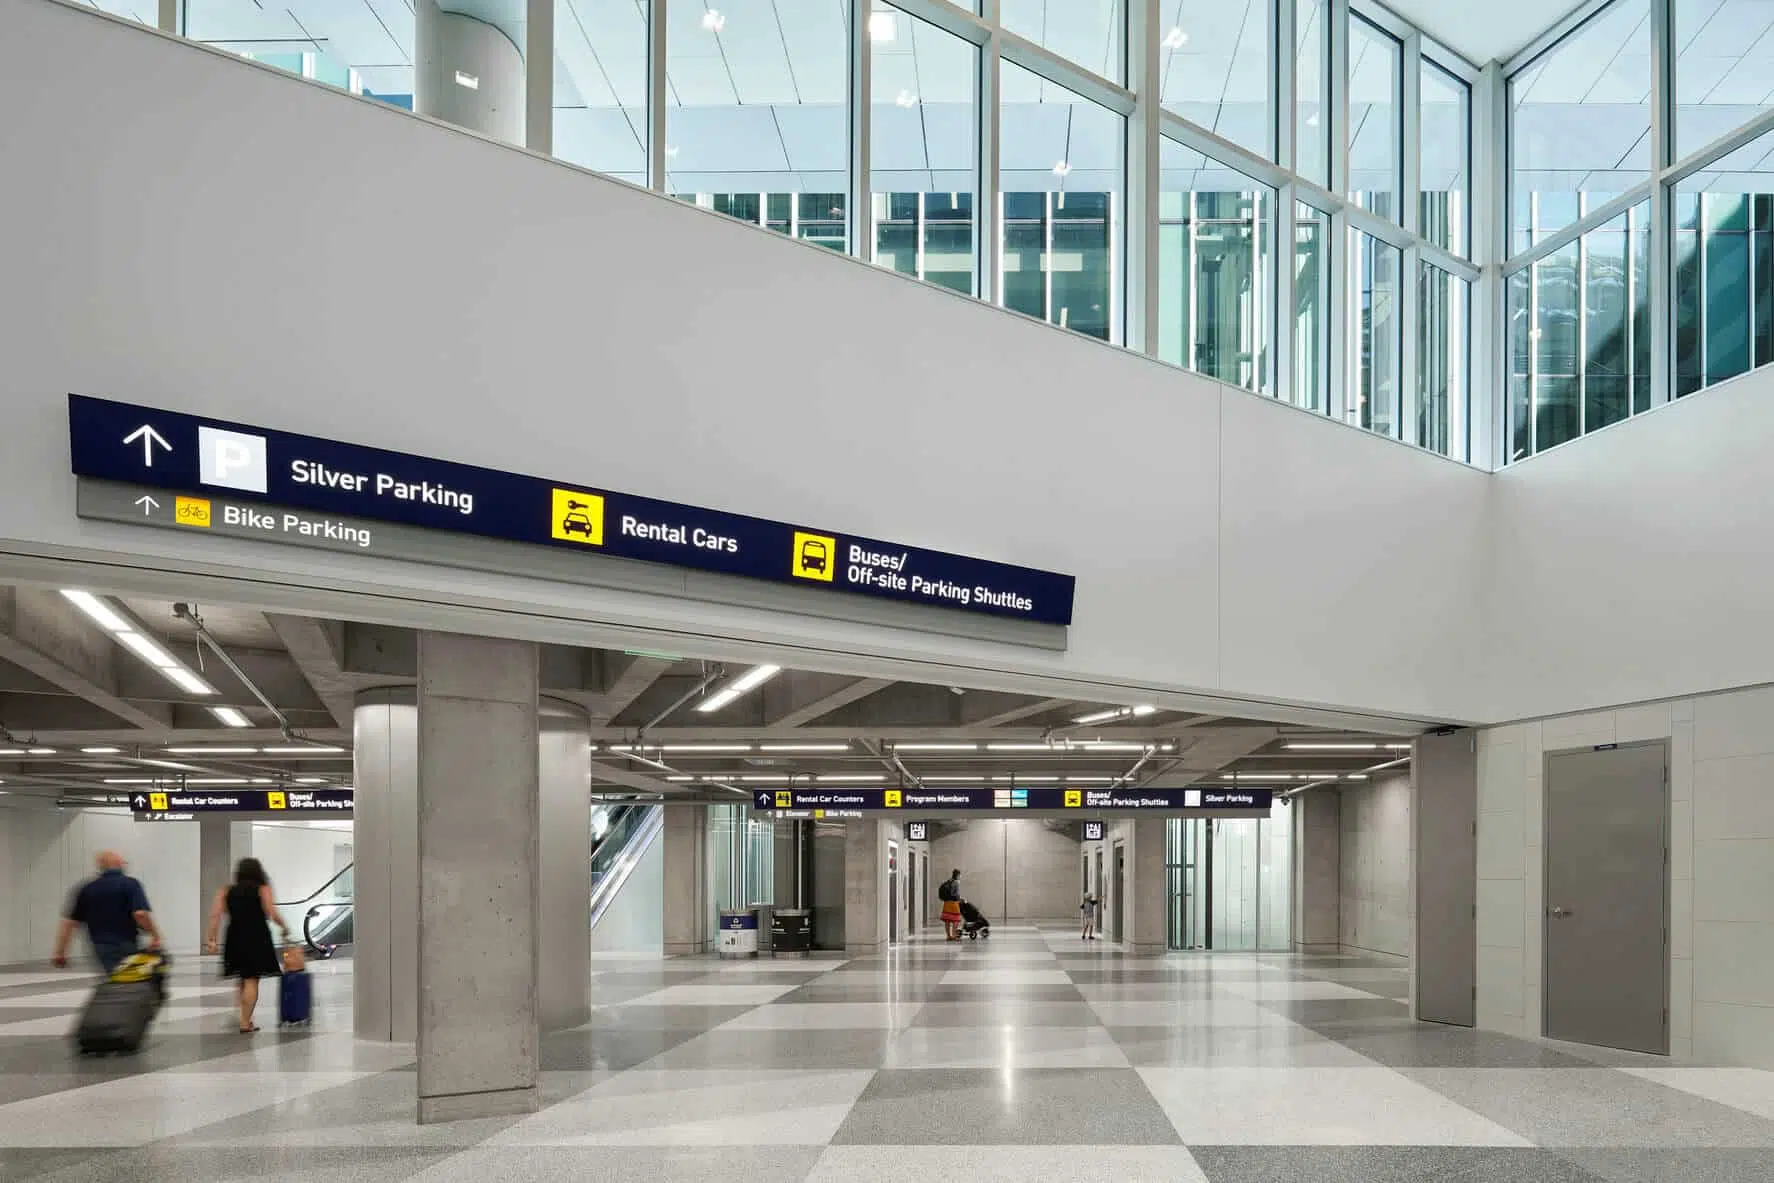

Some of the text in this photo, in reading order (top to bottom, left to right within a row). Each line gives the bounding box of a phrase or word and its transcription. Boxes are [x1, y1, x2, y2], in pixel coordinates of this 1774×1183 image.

[215, 440, 252, 479] P
[291, 460, 474, 514] Silver Parking
[224, 506, 371, 547] Bike Parking
[621, 515, 738, 553] Rental Cars
[848, 545, 907, 571] Buses/
[847, 566, 1033, 612] Off-site Parking Shuttles
[906, 795, 936, 804] Program
[1087, 791, 1112, 799] Buses/
[1205, 794, 1253, 804] Silver Parking
[194, 797, 206, 805] Car
[208, 797, 239, 805] Counters
[316, 800, 343, 809] Parking
[1113, 798, 1139, 807] Parking
[840, 810, 862, 818] Parking
